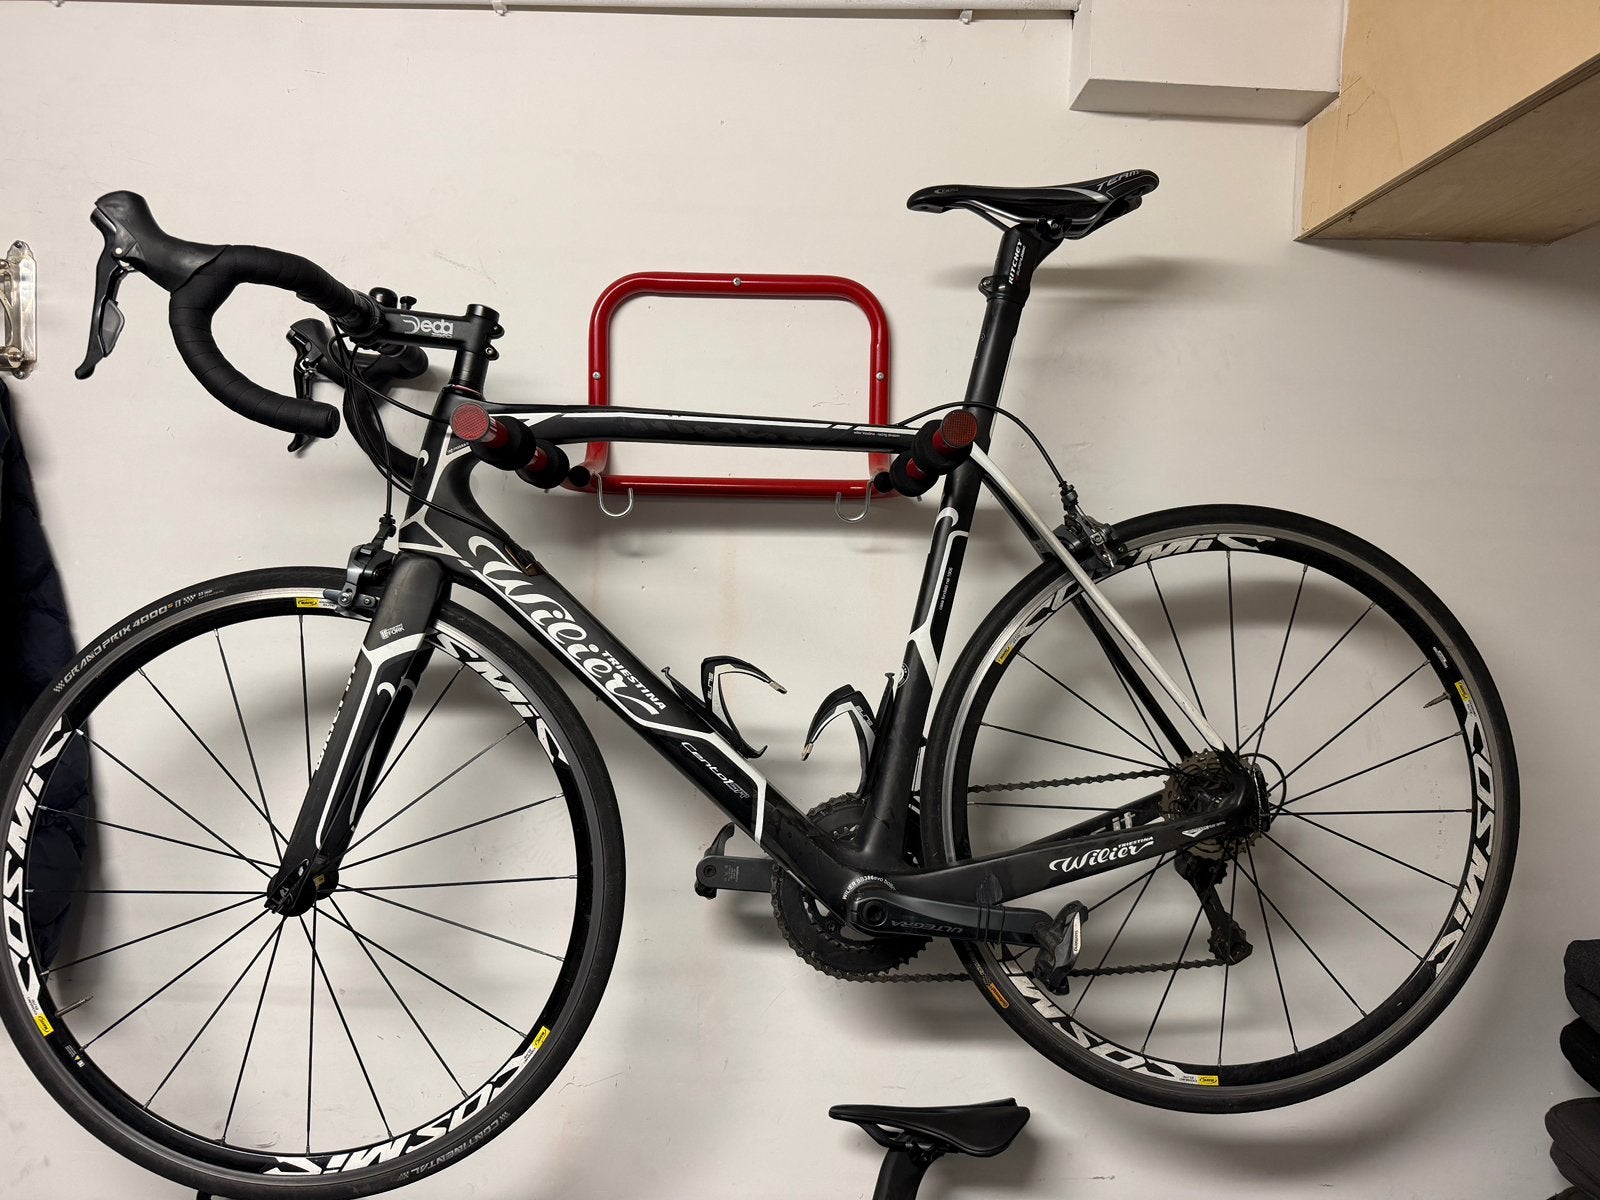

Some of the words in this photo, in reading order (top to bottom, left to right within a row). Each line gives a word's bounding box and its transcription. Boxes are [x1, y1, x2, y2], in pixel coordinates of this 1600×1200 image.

[1008, 238, 1023, 284] RITCHEY
[63, 644, 102, 684] GRAND
[102, 624, 131, 650] PRIX
[601, 650, 667, 710] TRIESTINA
[1049, 841, 1154, 872] Wilier
[1118, 836, 1154, 848] TRIESTINA
[891, 920, 964, 934] ULTEGRA
[410, 1118, 500, 1175] CONTINENTAL
